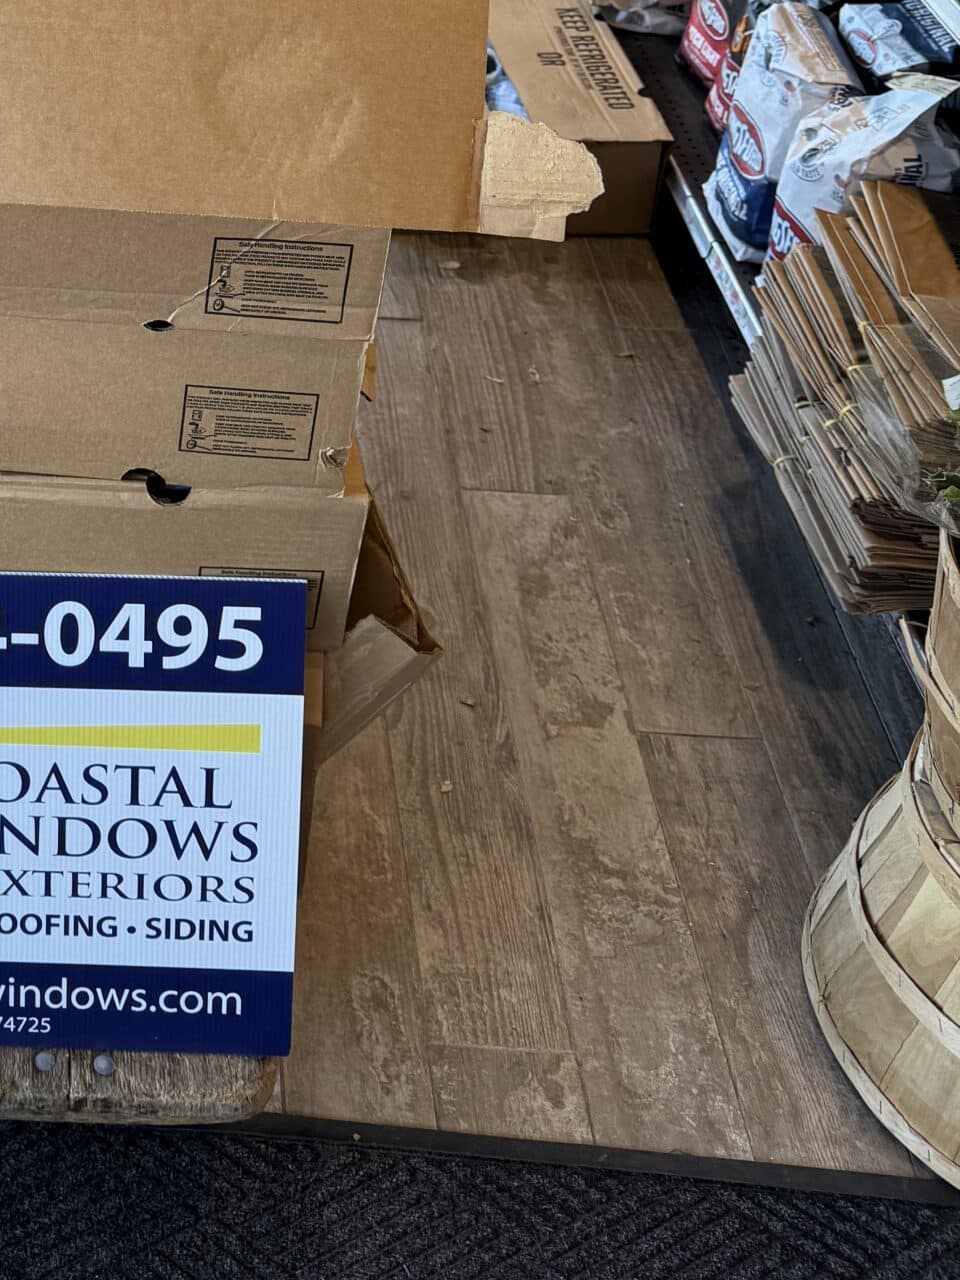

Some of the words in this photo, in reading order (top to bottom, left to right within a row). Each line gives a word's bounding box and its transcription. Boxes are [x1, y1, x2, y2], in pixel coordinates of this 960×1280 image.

[555, 8, 590, 36] KEEP
[537, 52, 566, 67] OR
[570, 35, 636, 111] REFRIGERATED
[254, 243, 283, 251] Handling
[284, 244, 323, 252] Instructions
[224, 391, 252, 399] Handling
[253, 392, 290, 400] Instructions
[146, 916, 255, 943] SIDING
